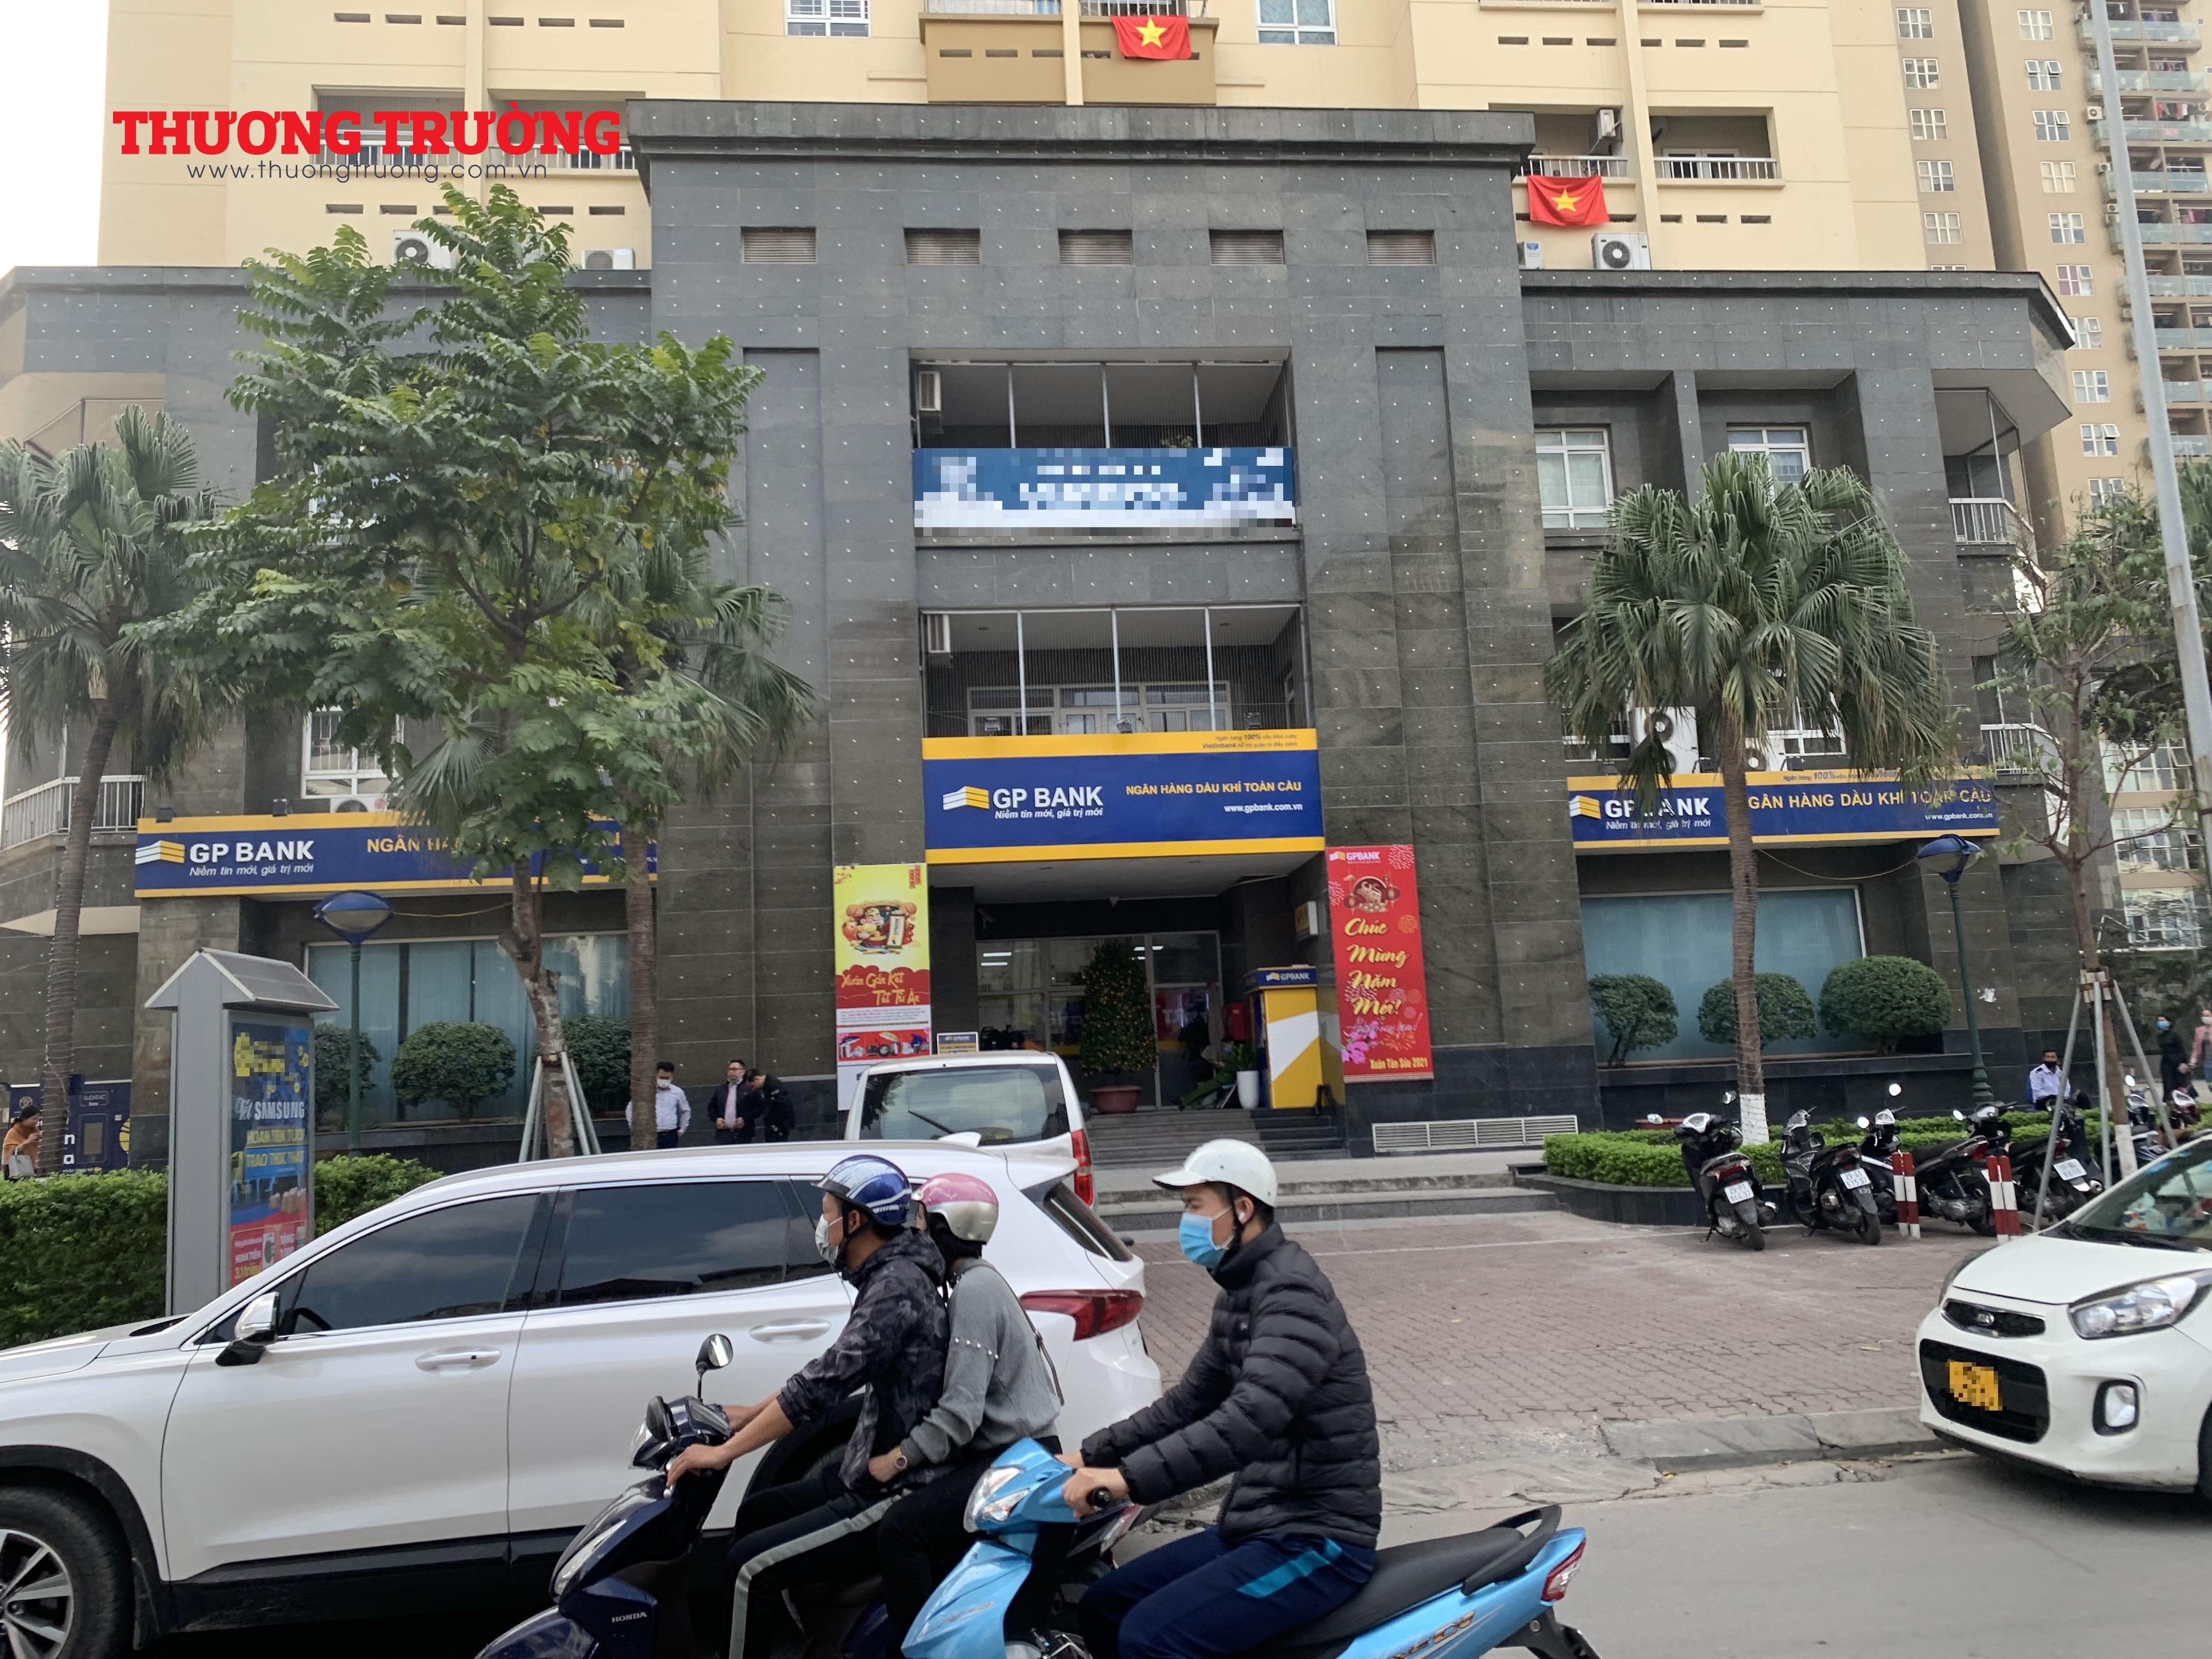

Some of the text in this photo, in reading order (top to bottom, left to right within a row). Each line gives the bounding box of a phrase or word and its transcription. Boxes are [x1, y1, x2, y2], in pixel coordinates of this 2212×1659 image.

[1814, 771, 1835, 780] 100%
[1126, 783, 1157, 795] NGÂN
[1160, 782, 1193, 794] HÀNG
[1222, 781, 1241, 793] KHÍ
[1244, 780, 1274, 792] TOÀN
[993, 786, 1103, 809] GP BANK
[1641, 797, 1711, 817] ANK
[1748, 795, 1783, 809] GÂN
[1789, 792, 1835, 808] HÀNG
[1878, 789, 1904, 805] KHÍ
[995, 809, 1018, 819] Niềm
[1020, 809, 1032, 817] tin
[1057, 808, 1070, 819] giá
[1073, 809, 1083, 818] trị
[1085, 808, 1103, 816] mới
[1224, 803, 1303, 814] www.gpbank.com.vn
[1694, 819, 1711, 827] mới
[190, 840, 315, 863] GP BANK
[367, 834, 420, 853] NGÂN
[1346, 851, 1381, 861] GPBANK
[189, 865, 217, 876] Niềm
[221, 865, 233, 876] tin
[261, 864, 276, 876] giá
[280, 864, 291, 876] trị
[294, 863, 314, 873] mới
[1344, 917, 1389, 936] Chúc
[1347, 944, 1409, 968] Mừng
[1280, 972, 1311, 980] GPBANK
[1348, 969, 1398, 989] Năm
[1352, 997, 1401, 1016] Mới!
[254, 1101, 305, 1120] SAMSUNG
[612, 1612, 647, 1623] HONDA
